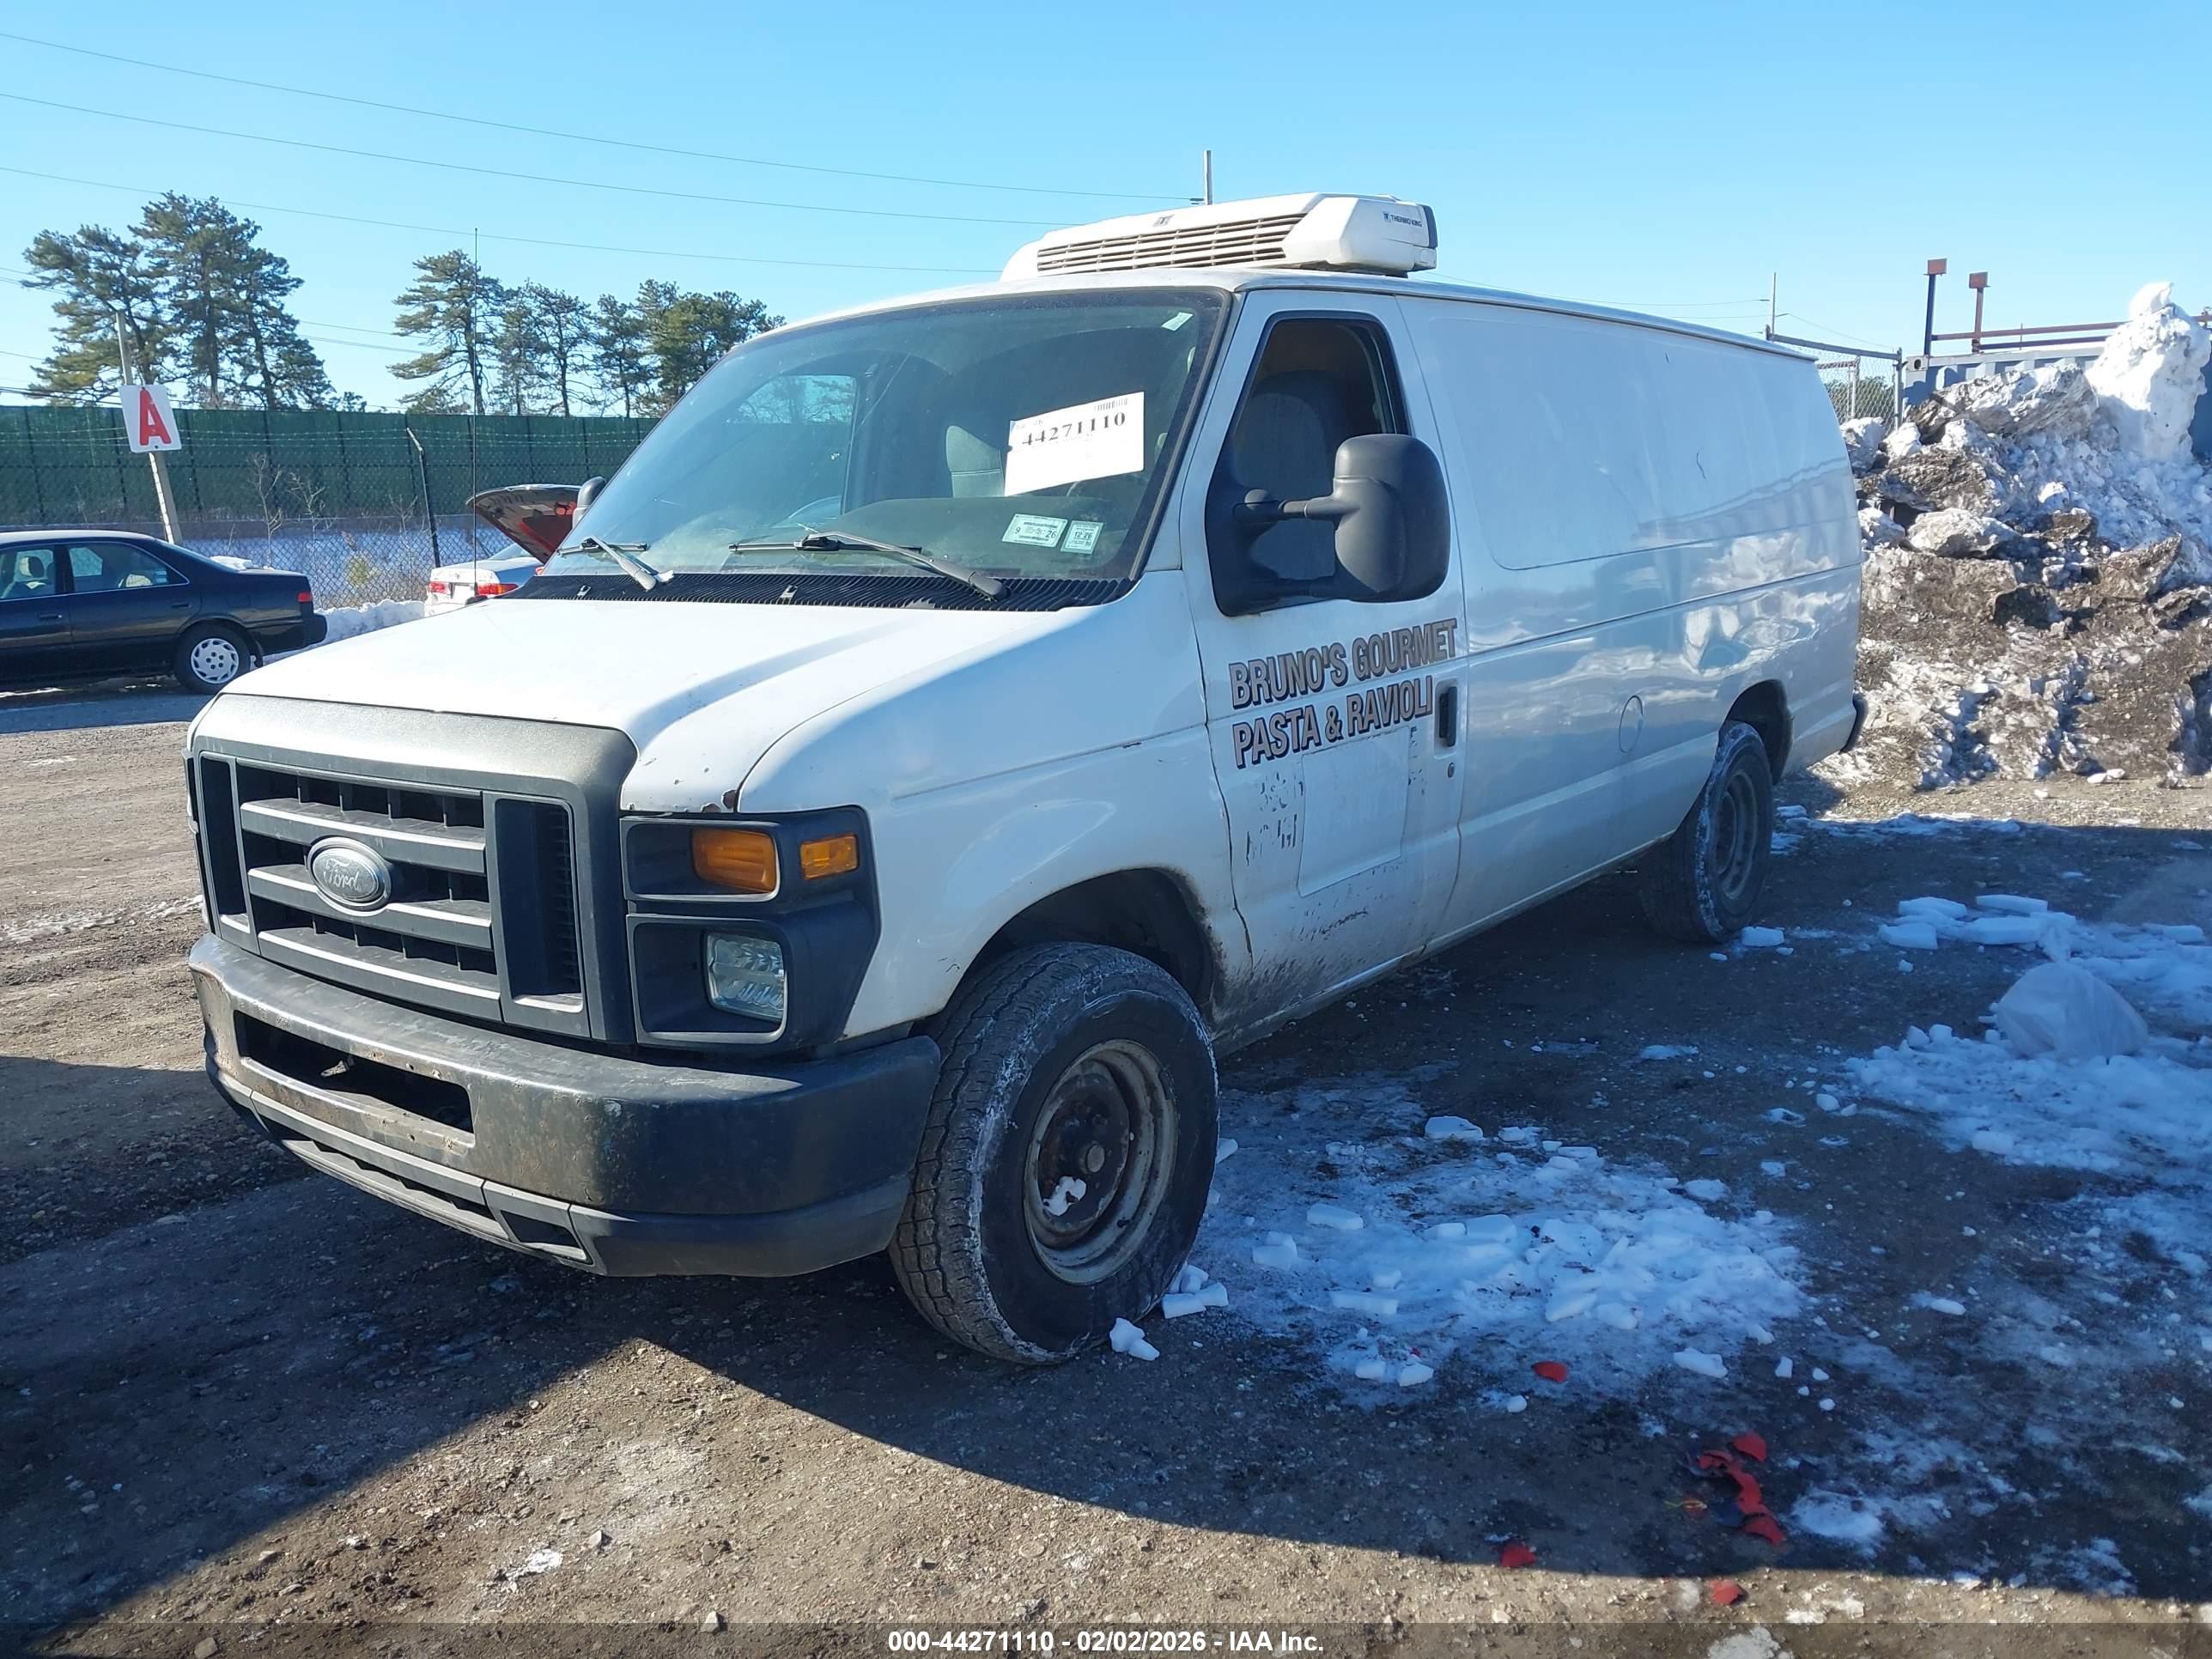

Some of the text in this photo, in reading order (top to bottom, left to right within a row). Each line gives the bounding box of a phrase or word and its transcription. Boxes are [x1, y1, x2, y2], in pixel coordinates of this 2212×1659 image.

[140, 388, 172, 446] A
[1022, 412, 1126, 446] 44271110
[1229, 617, 1457, 709] BRUNO'S GOURMET
[1232, 675, 1433, 769] PASTA & RAVIOLI
[324, 858, 361, 891] Ford
